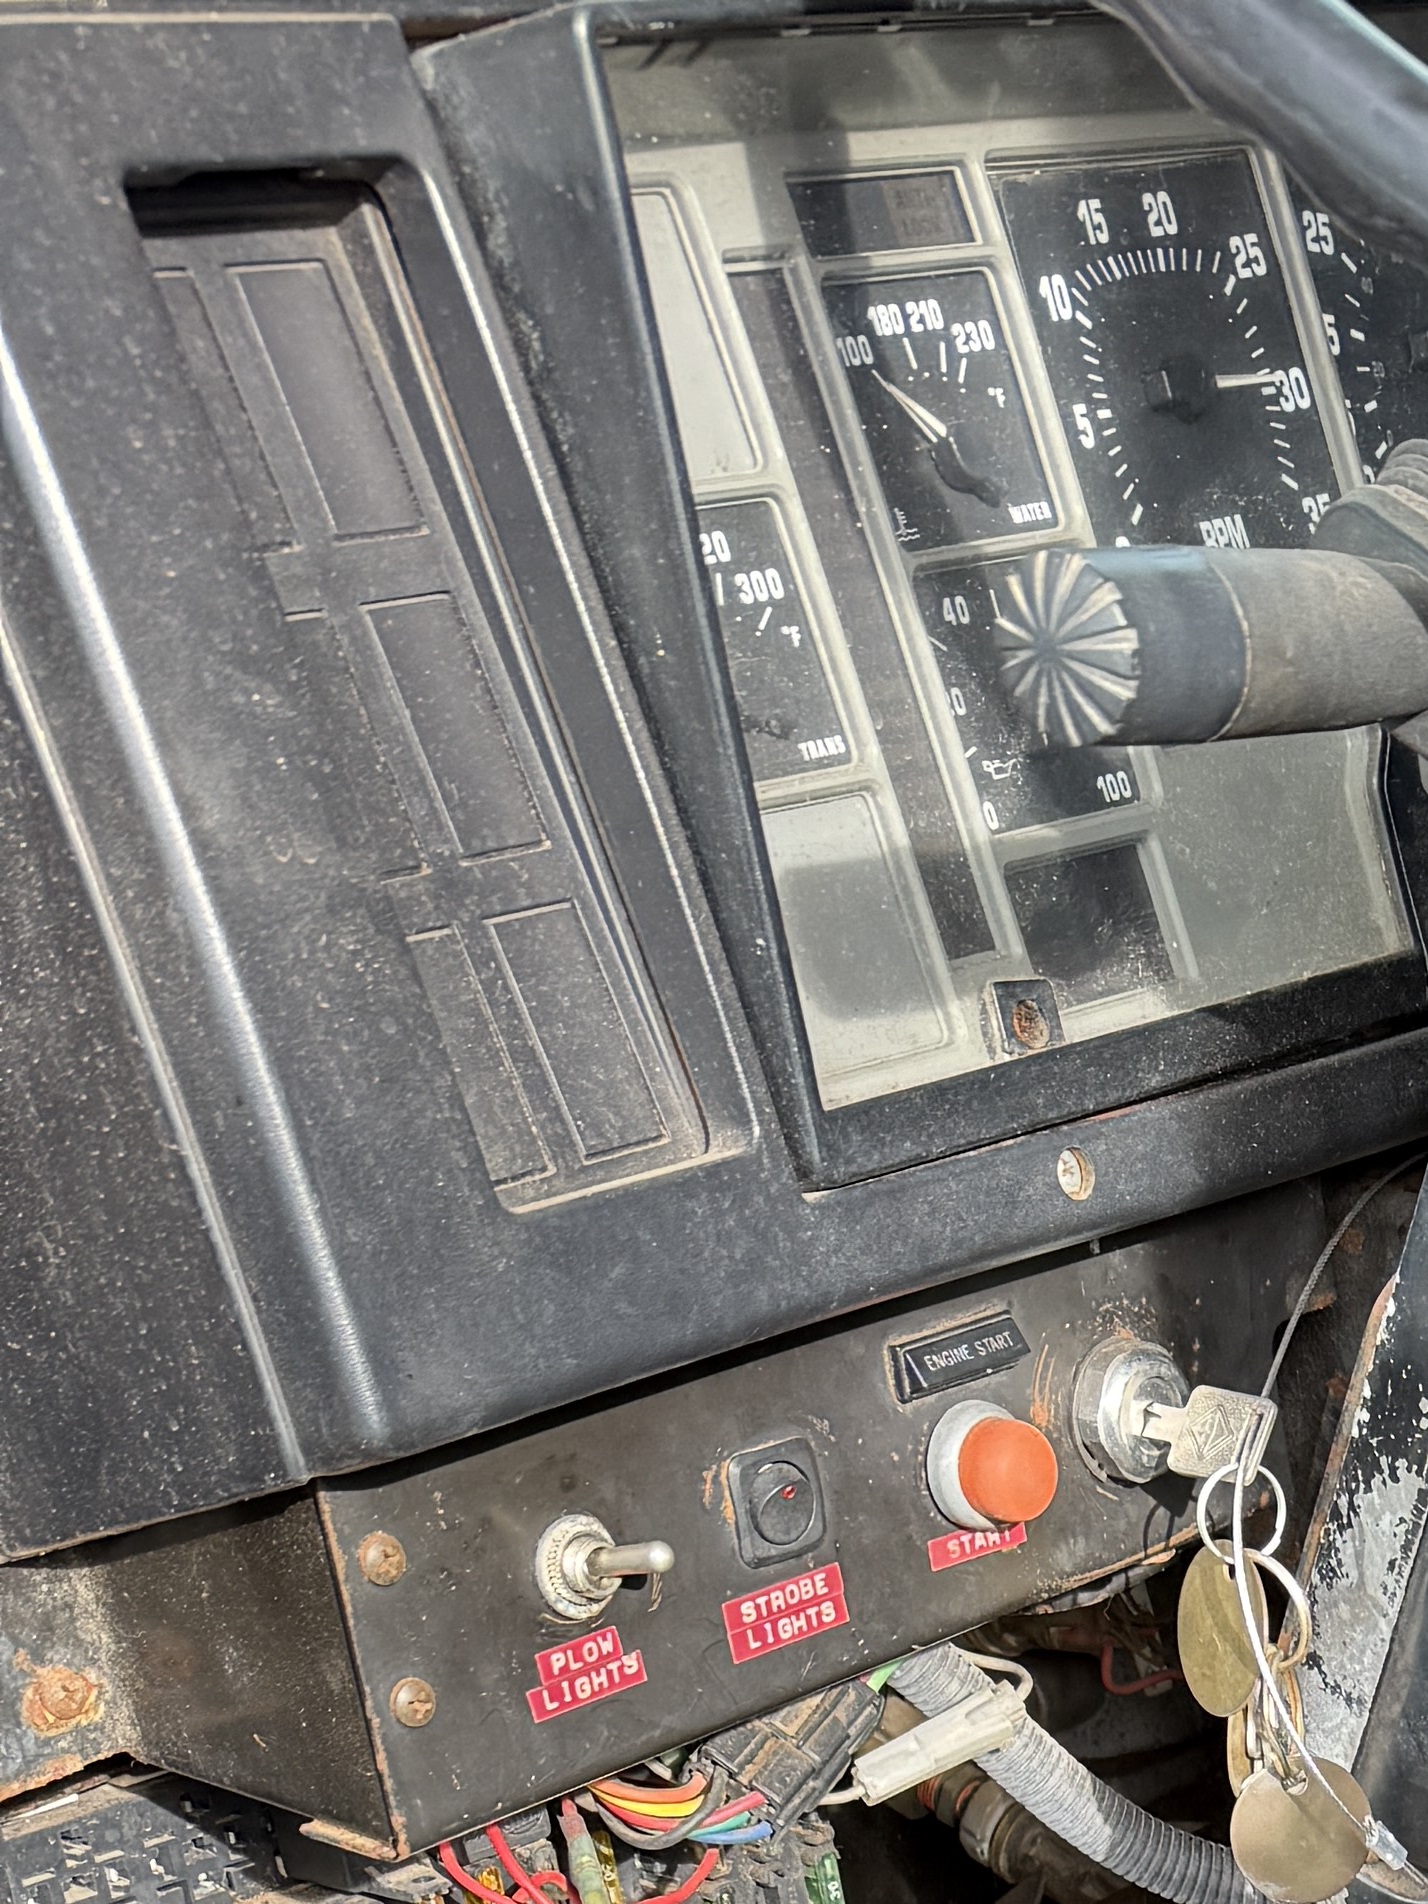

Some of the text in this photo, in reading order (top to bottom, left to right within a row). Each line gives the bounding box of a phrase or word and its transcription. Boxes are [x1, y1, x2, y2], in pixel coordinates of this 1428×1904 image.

[1078, 191, 1178, 245] 15 20
[1302, 210, 1335, 256] 25
[1229, 233, 1267, 279] 25
[867, 299, 944, 336] 180 210
[1039, 274, 1073, 321] 10
[836, 320, 995, 367] 100 230
[1274, 366, 1311, 412] 30
[1073, 404, 1095, 449] 5
[1007, 501, 1052, 524] WATER
[1199, 514, 1250, 550] RPM
[734, 567, 785, 604] 300
[942, 595, 970, 626] 40
[798, 735, 846, 761] TRANS
[1096, 771, 1133, 803] 100
[983, 801, 999, 831] 0
[923, 1330, 1013, 1373] ENGINE START
[740, 1573, 829, 1624] STROBE
[747, 1602, 837, 1650] LIGHTS
[550, 1634, 615, 1676] PLOW
[541, 1656, 640, 1711] LIGHTS
